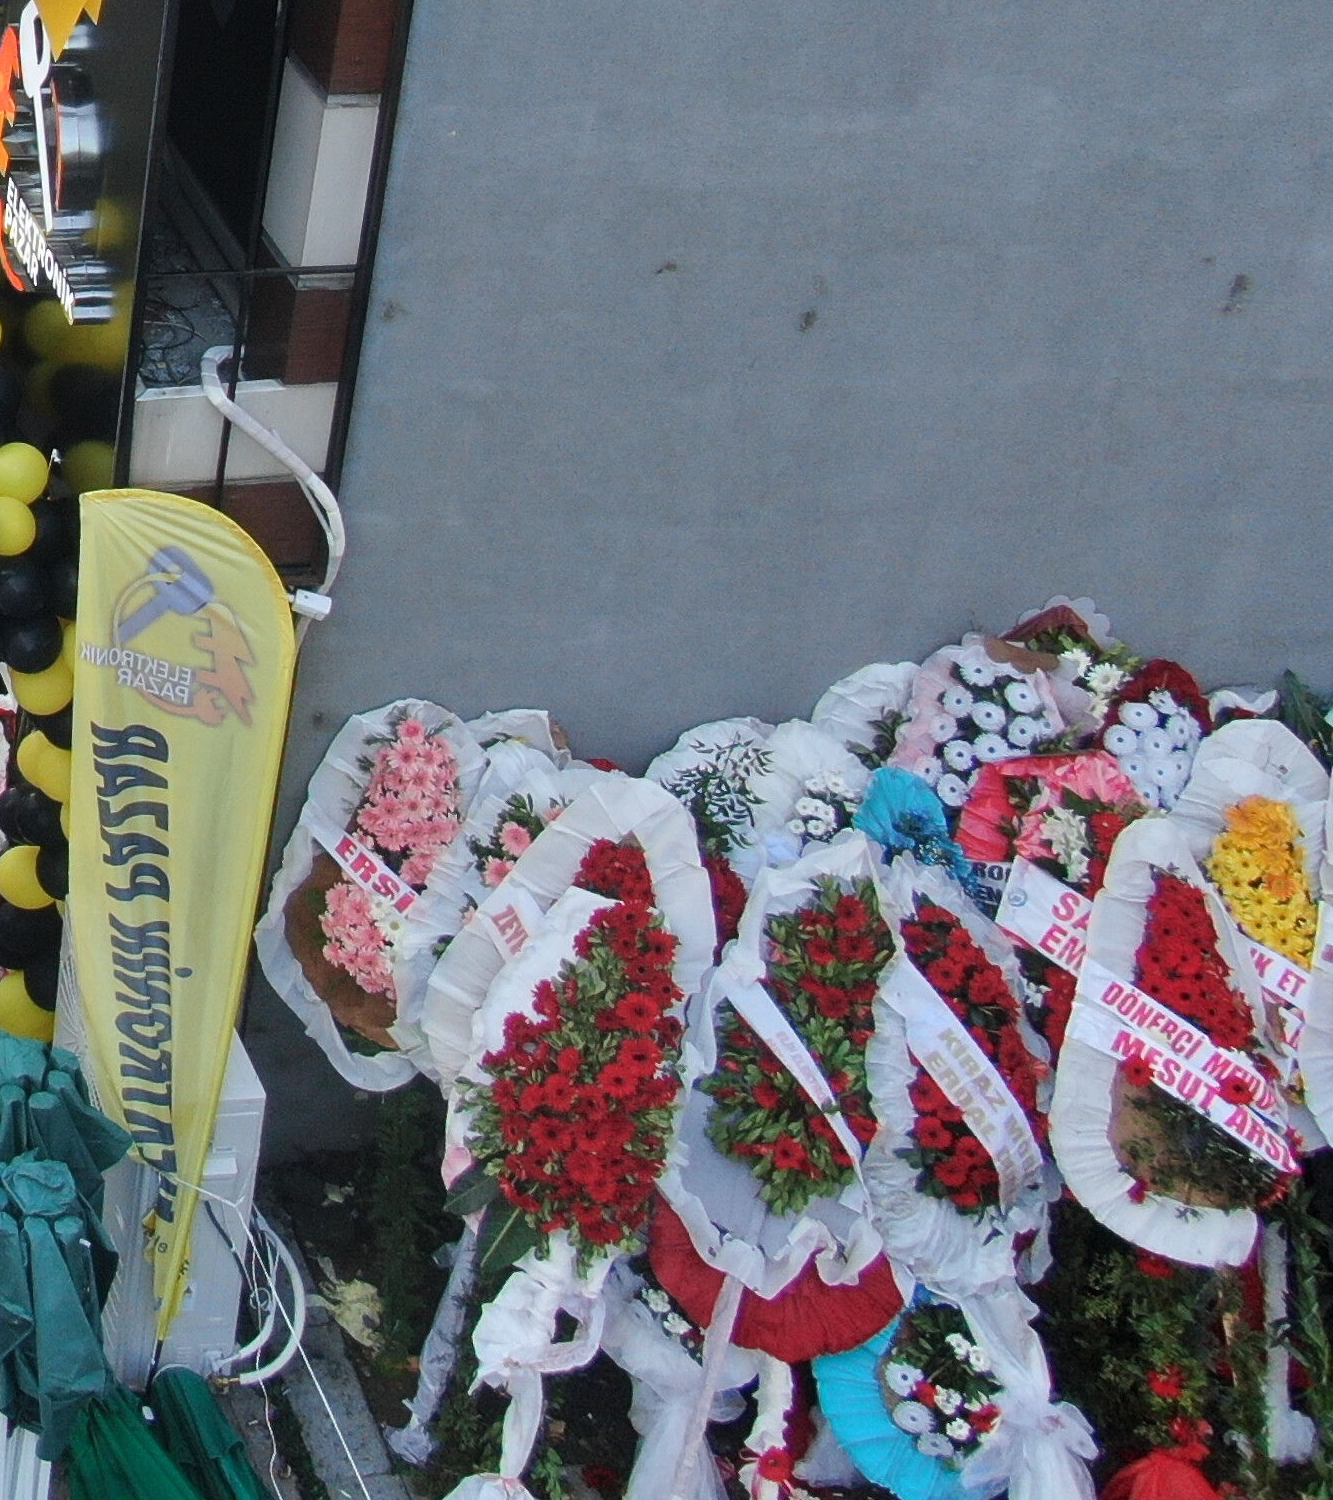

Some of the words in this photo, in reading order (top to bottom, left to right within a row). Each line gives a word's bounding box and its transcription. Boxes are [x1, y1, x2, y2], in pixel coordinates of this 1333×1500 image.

[3, 201, 40, 287] PAZAR
[6, 177, 76, 326] ELEKTRONİK
[1277, 967, 1307, 998] ET
